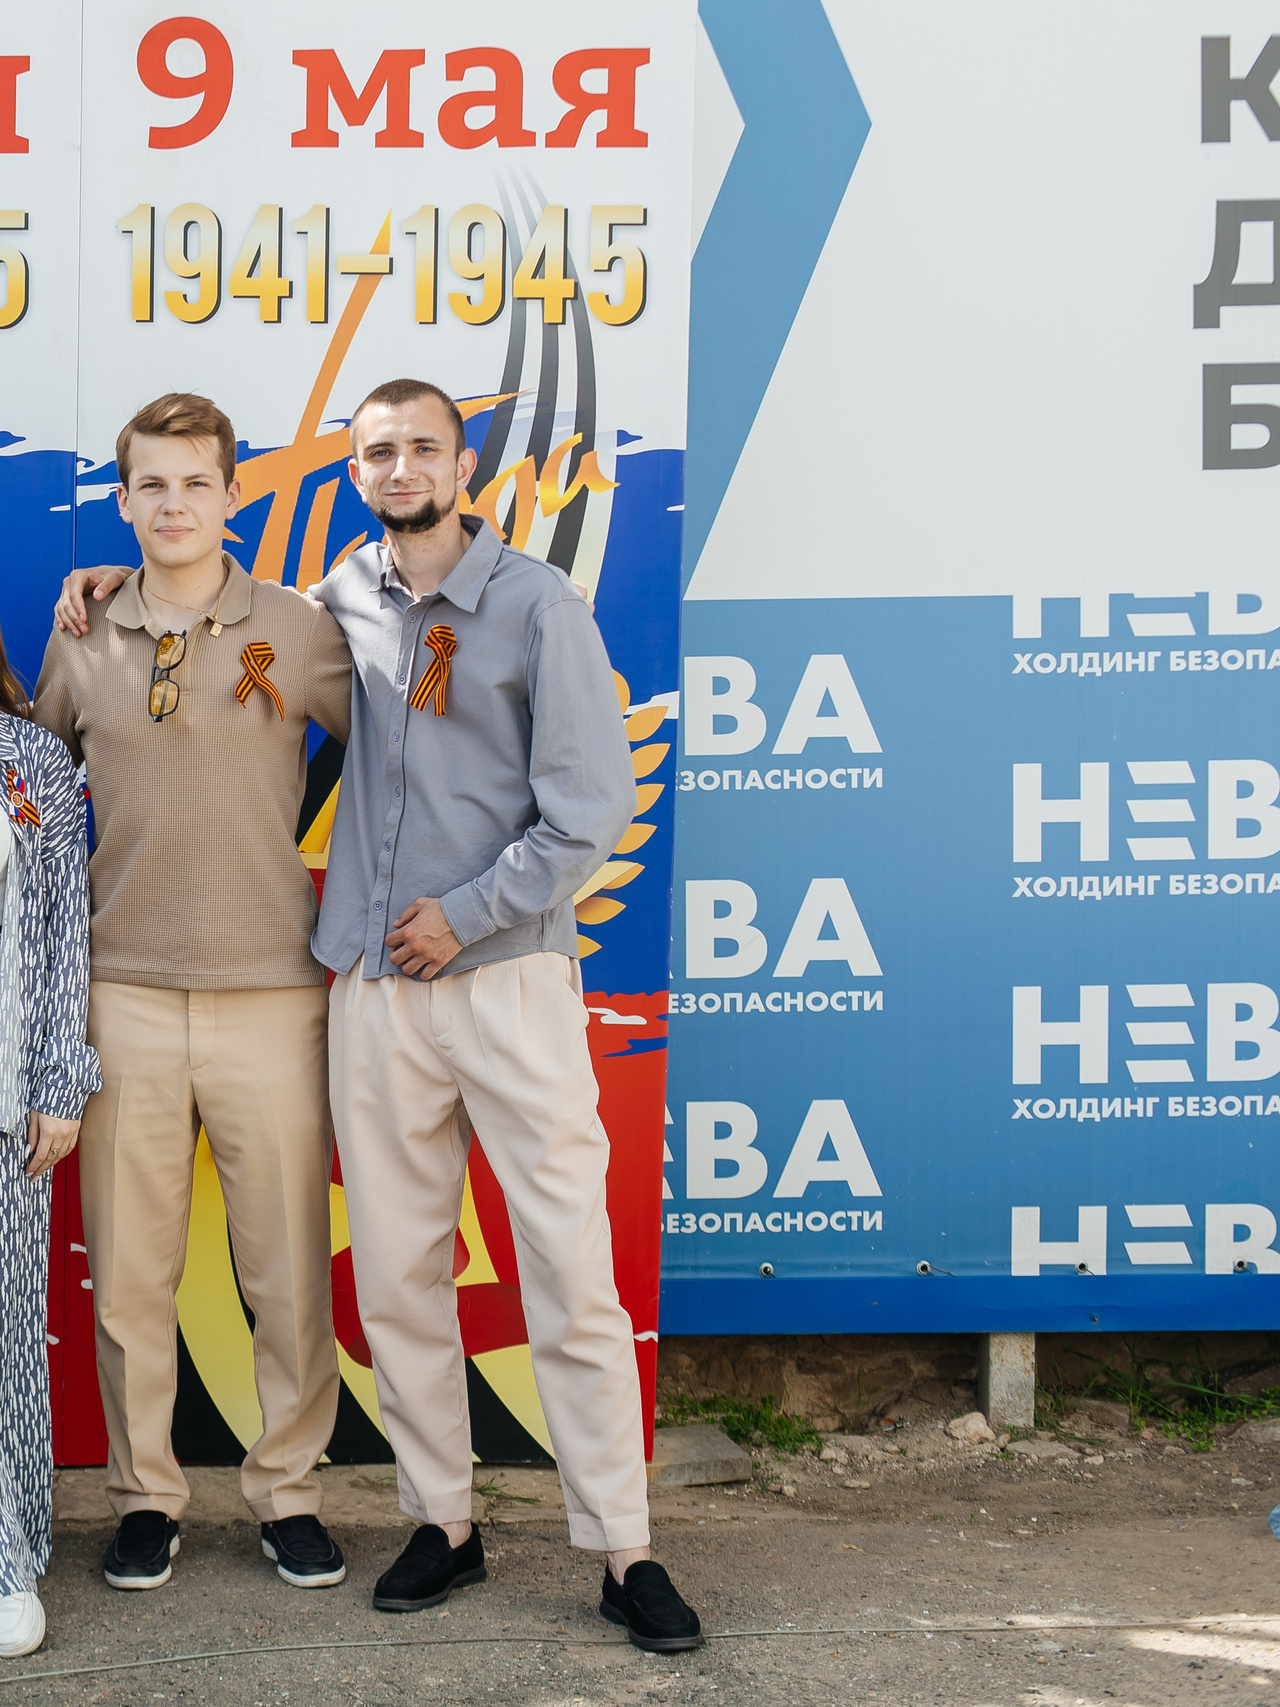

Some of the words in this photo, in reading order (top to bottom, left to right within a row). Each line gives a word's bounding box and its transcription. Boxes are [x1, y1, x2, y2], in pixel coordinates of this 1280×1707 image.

[136, 16, 234, 150] 9
[291, 46, 651, 150] мая
[1012, 650, 1162, 677] ХОЛДИНГ
[676, 767, 884, 792] ЗОПАСНОСТИ
[1012, 874, 1161, 901] ХОЛДИНГ
[669, 877, 884, 979] ВА
[1011, 1097, 1160, 1123] ХОЛДИНГ
[663, 1099, 884, 1200] ВА
[661, 1210, 883, 1234] ЕЗОПАСНОСТИ
